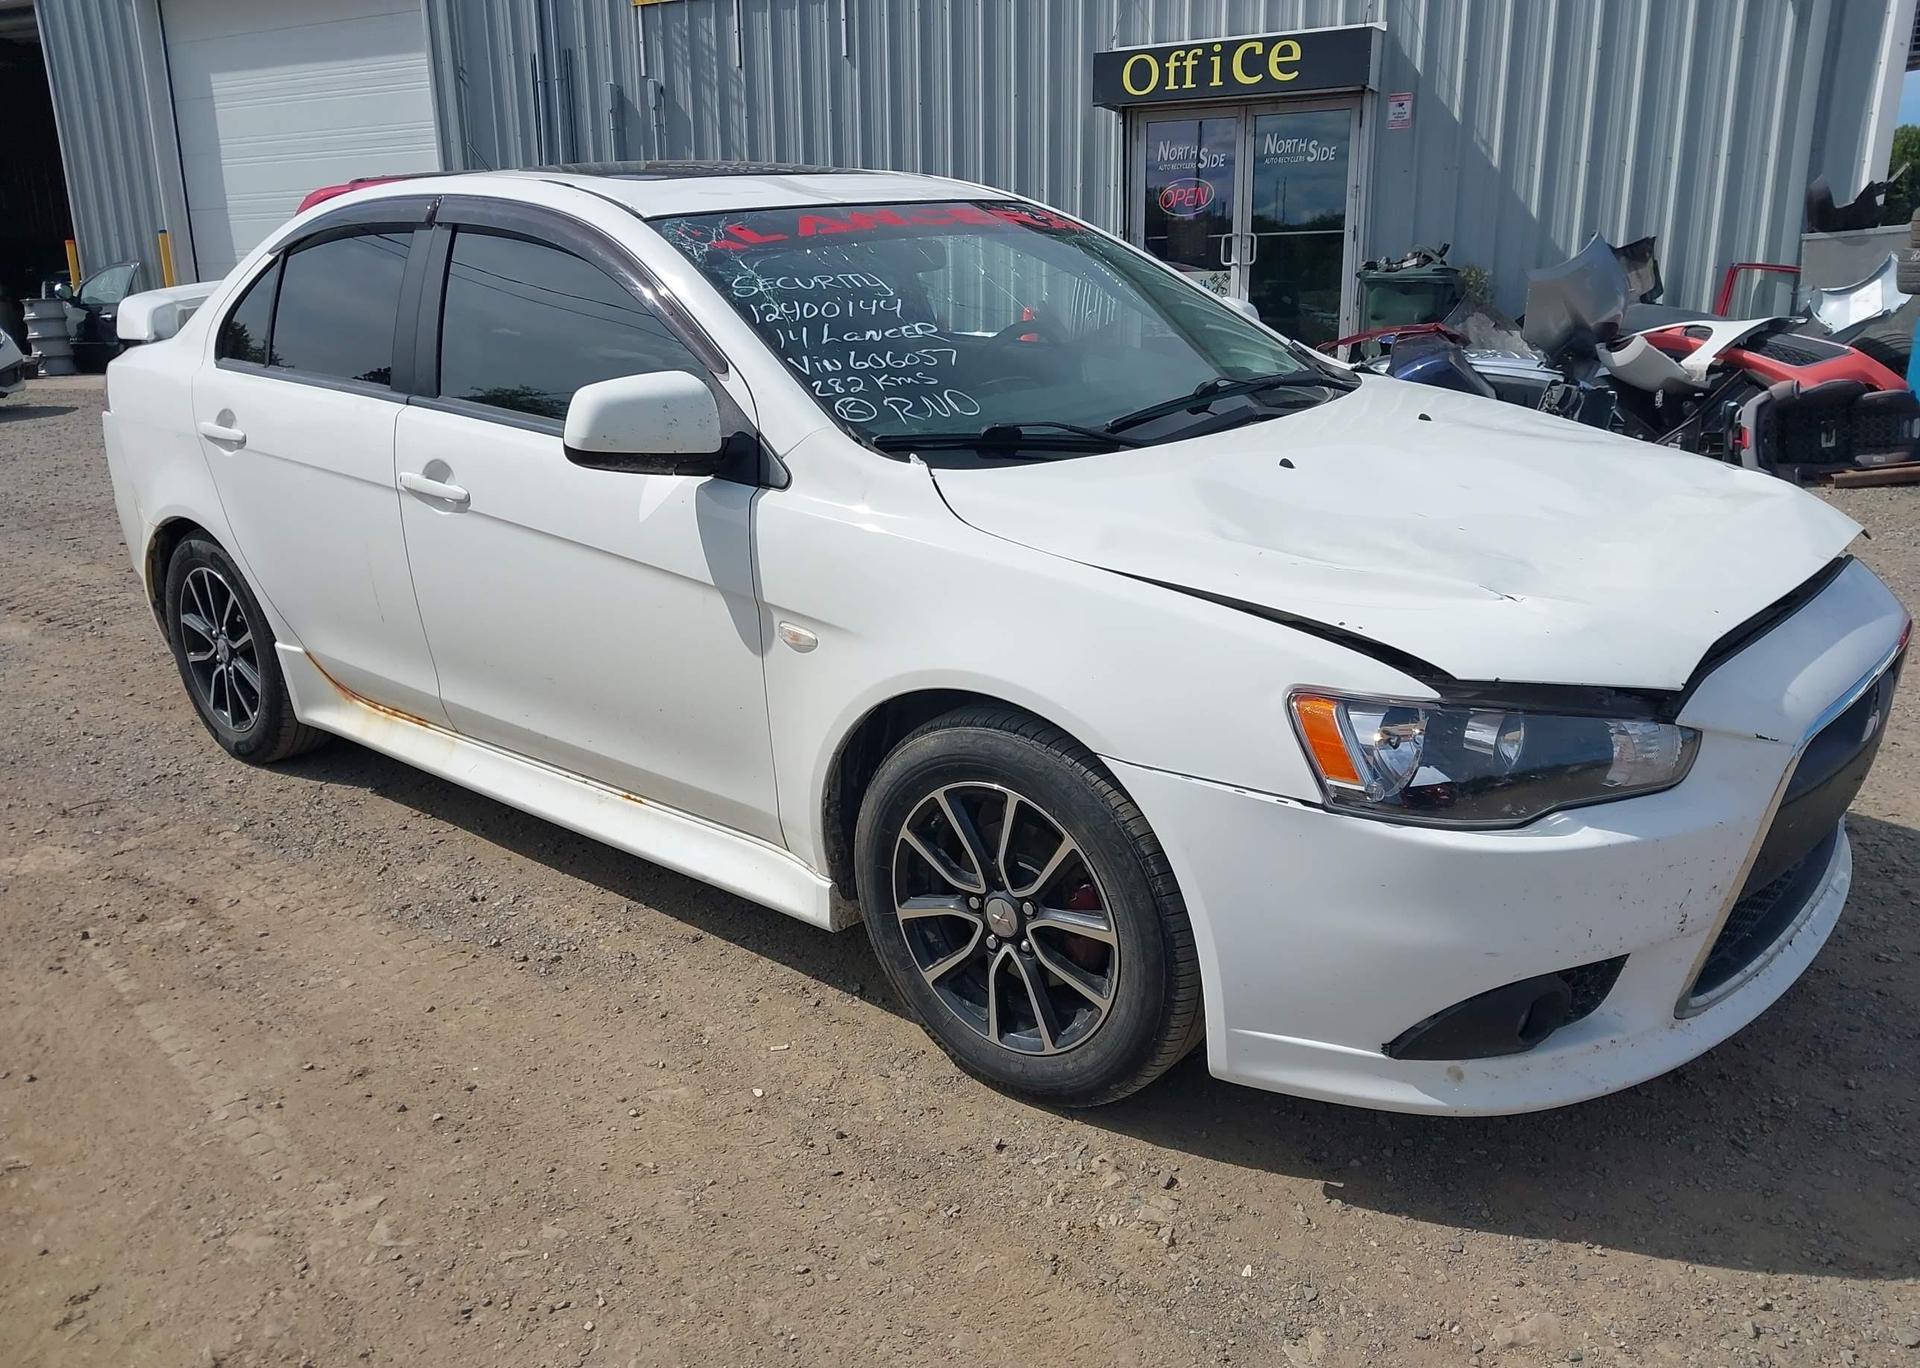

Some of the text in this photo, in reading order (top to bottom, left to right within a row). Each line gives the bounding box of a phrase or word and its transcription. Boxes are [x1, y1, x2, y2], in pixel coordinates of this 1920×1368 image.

[1121, 39, 1303, 97] Office
[1157, 140, 1226, 169] NORTH SIDE
[1263, 132, 1337, 162] NORTH SIDE
[1161, 187, 1210, 208] OPEN
[750, 298, 902, 324] 12400144
[776, 327, 808, 349] 14
[812, 377, 869, 397] 282
